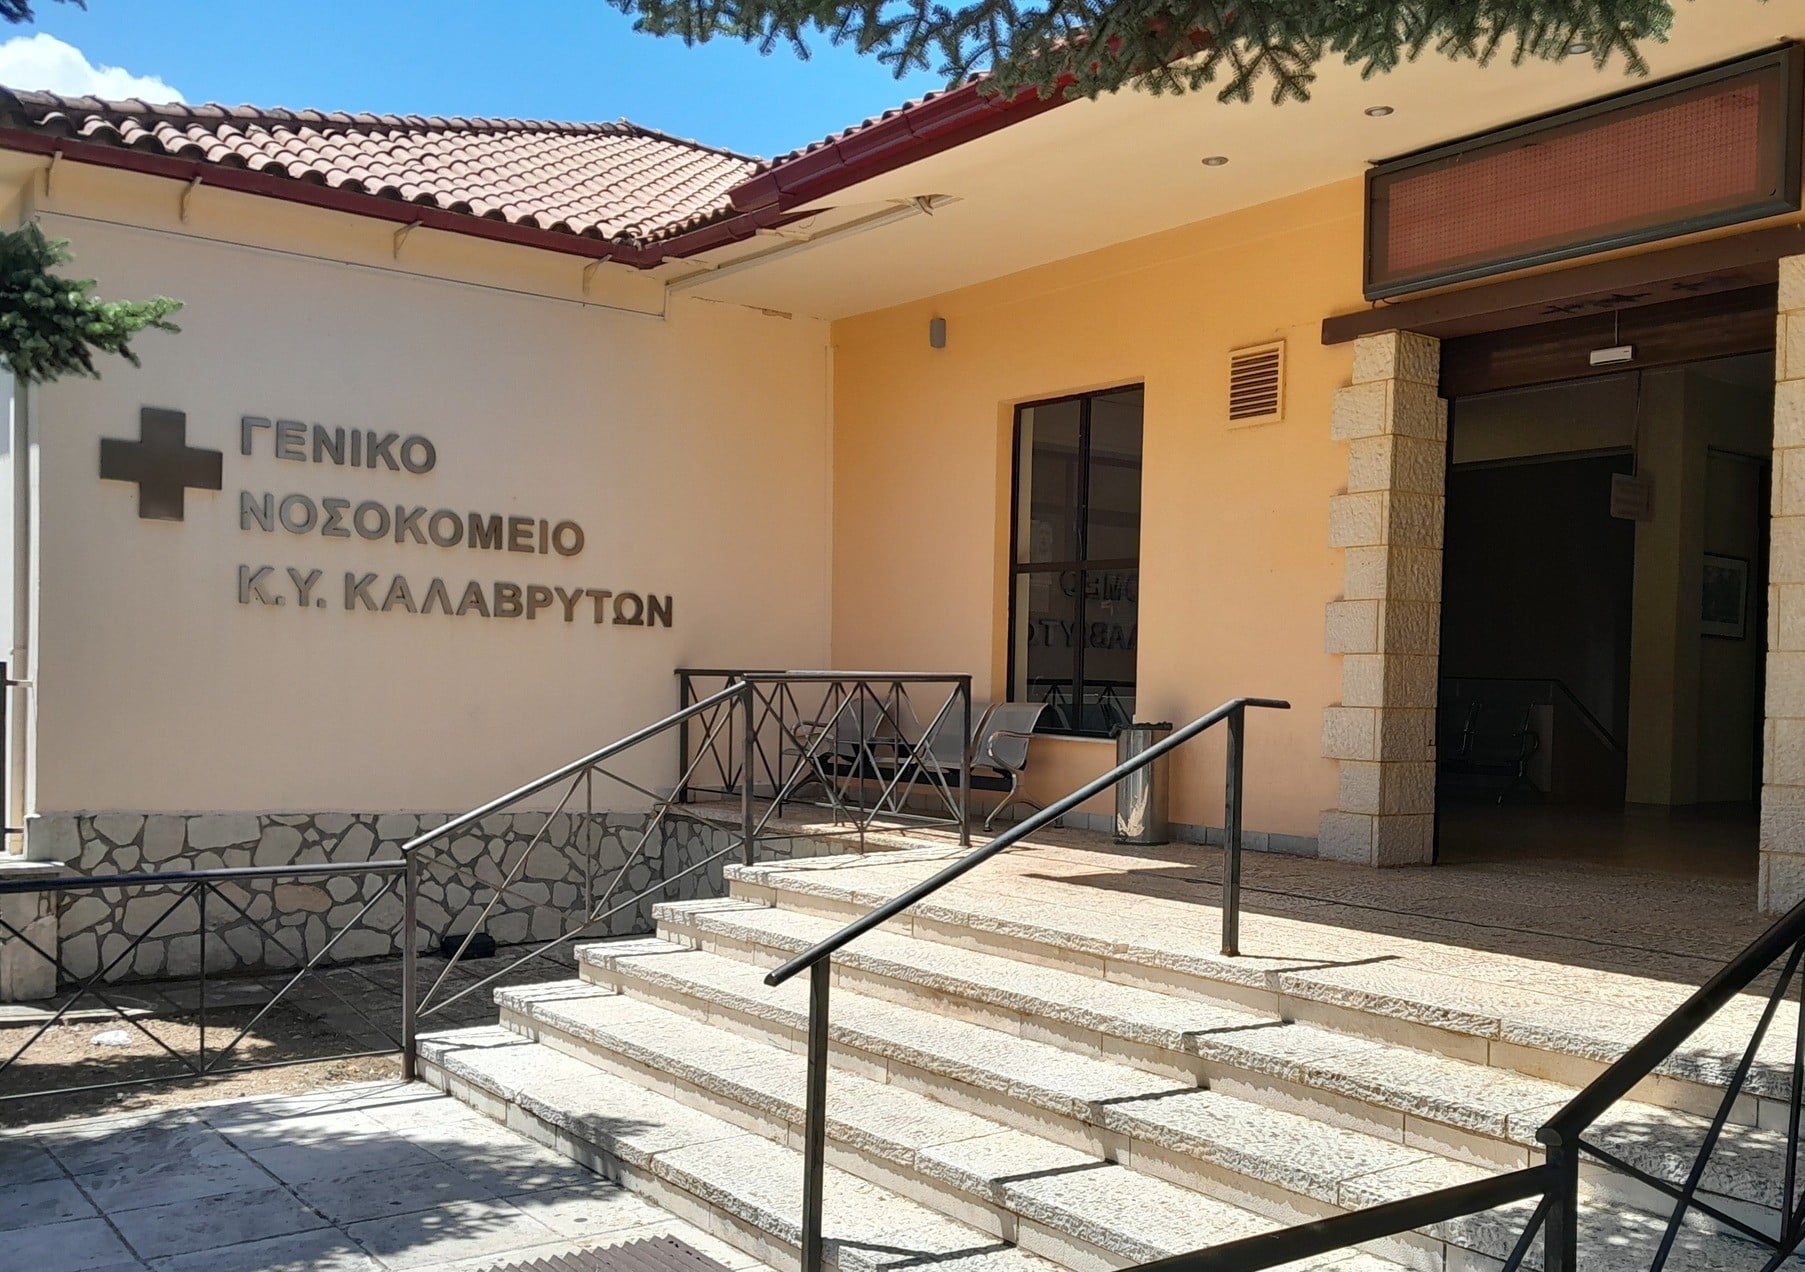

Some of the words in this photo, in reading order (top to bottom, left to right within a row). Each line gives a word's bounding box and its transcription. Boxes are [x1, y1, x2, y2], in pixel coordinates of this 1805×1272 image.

[241, 416, 437, 474] ΓΕΝΙΚΟ
[240, 491, 585, 556] ΝΟΣΟΚΟΜΕΙΟ
[239, 565, 327, 609] Κ.Υ.
[344, 572, 673, 628] ΚΑΛΑΒΡΥΤΩΝ
